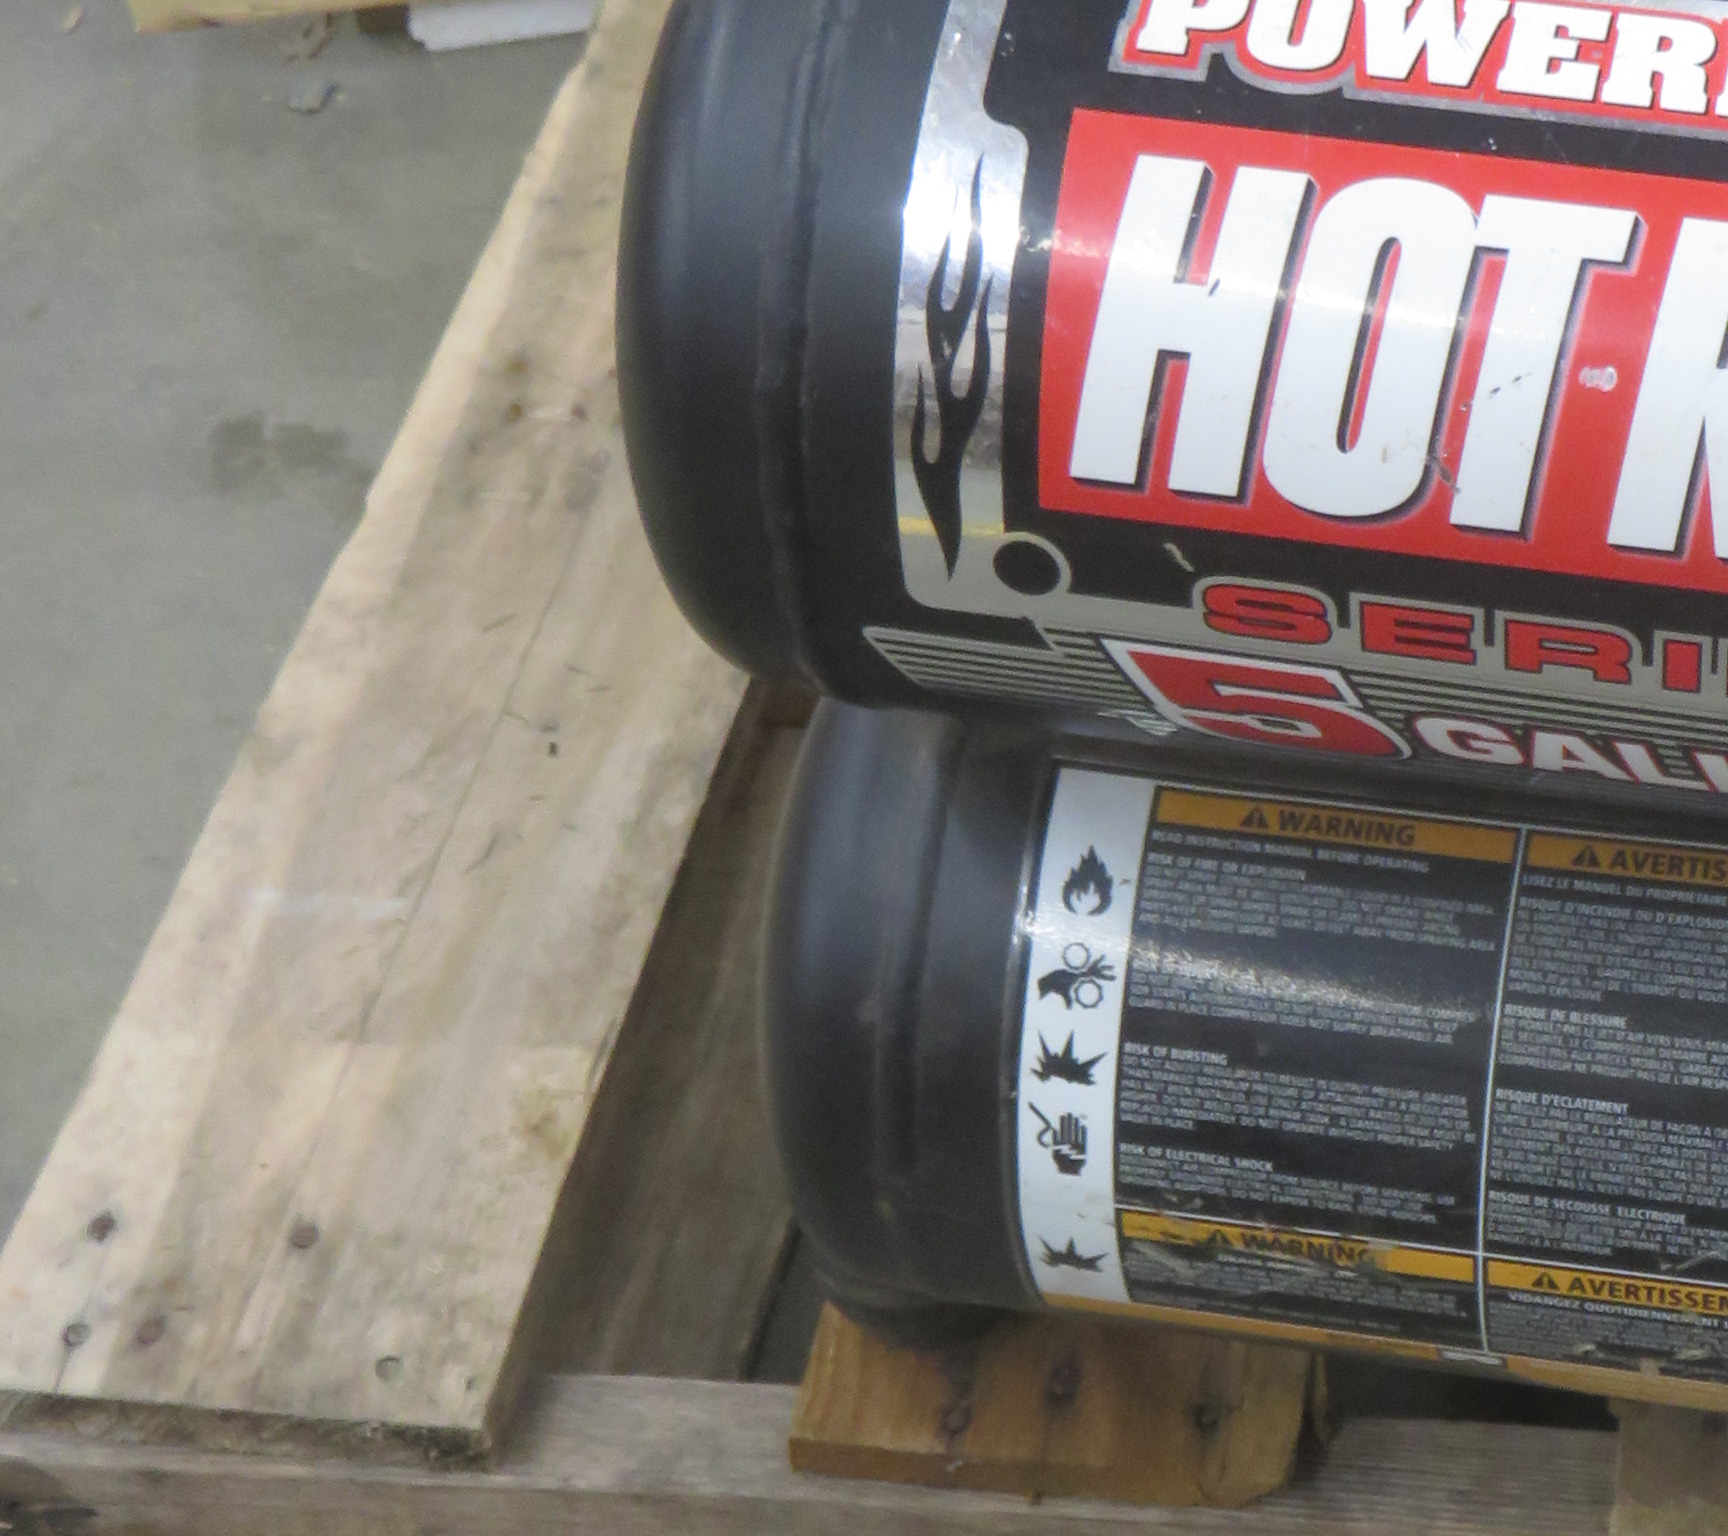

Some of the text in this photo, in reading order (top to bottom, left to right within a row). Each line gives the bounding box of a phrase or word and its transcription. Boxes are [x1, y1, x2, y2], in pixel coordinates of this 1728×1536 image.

[1067, 153, 1643, 540] HOT
[1103, 640, 1411, 760] 5
[1278, 809, 1417, 847] WARNING
[1503, 1003, 1627, 1029] RISQUE DE BLESSURE
[1123, 1041, 1228, 1065] RISK OF BURSTING
[1495, 1087, 1628, 1114] RISQUE D'ECLATEMENT
[1118, 1142, 1274, 1172] RISK OF ELECTRICAL SHOCK
[1487, 1190, 1686, 1225] RISQUE DE SECOUSSE ELECTRIQUE
